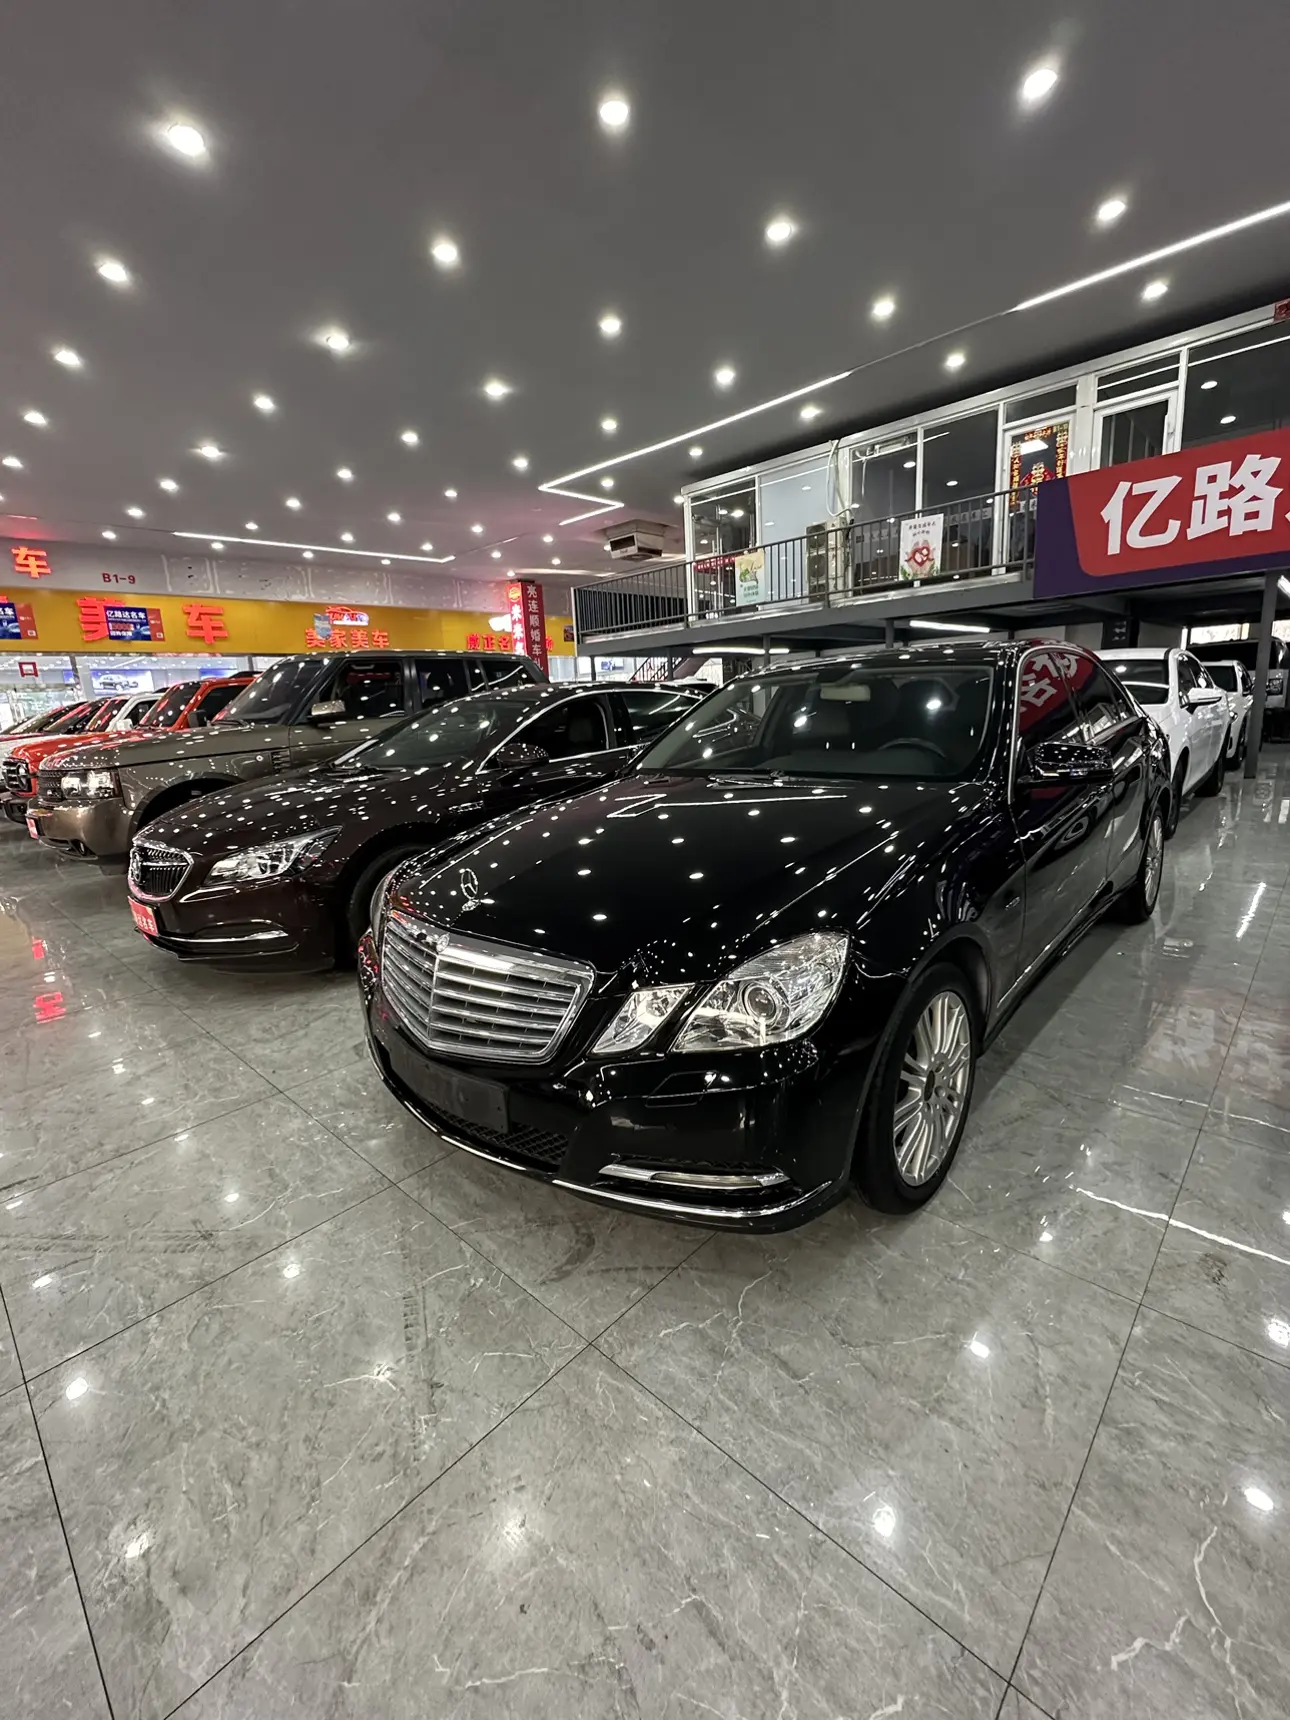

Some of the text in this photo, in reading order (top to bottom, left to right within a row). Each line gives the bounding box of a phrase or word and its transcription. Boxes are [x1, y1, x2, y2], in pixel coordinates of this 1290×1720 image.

[1100, 453, 1290, 556] 亿路
[11, 546, 52, 578] 车
[102, 573, 136, 584] B1-9
